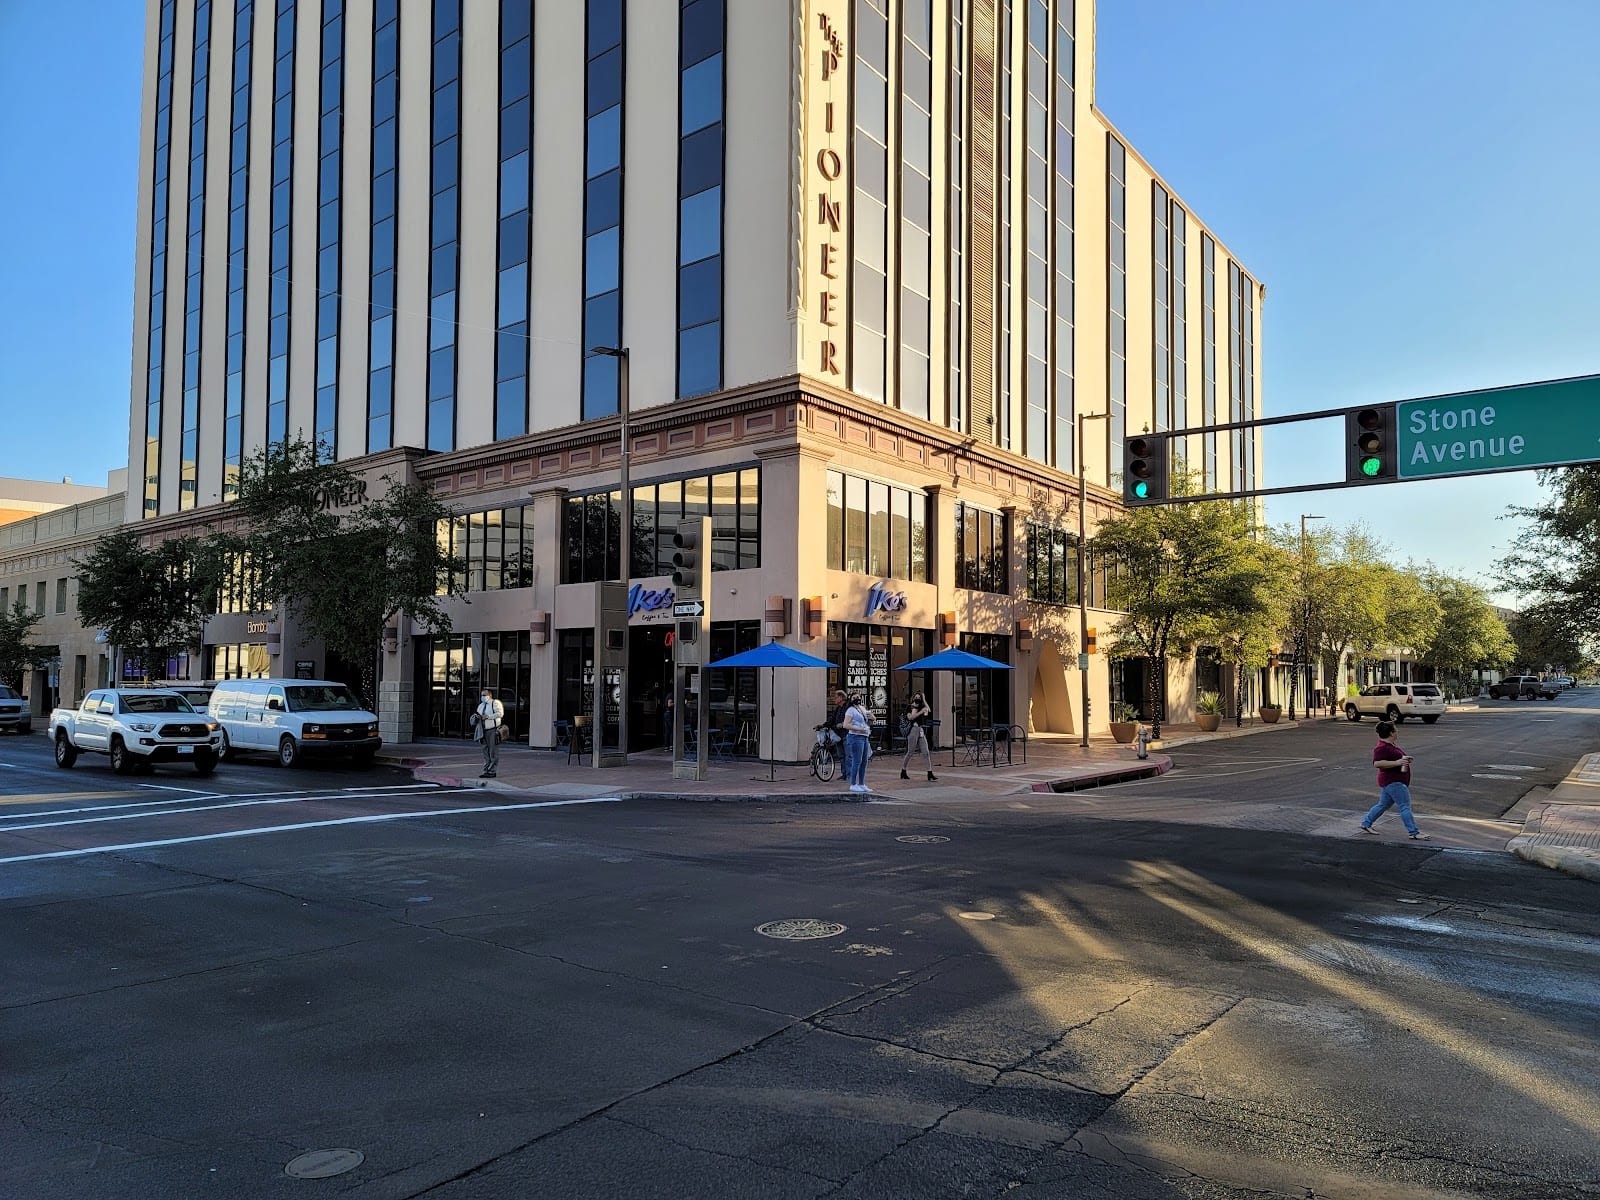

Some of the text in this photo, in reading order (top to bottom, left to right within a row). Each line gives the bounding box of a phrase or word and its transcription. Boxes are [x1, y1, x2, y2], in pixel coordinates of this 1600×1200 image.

[817, 50, 841, 375] PIONEER
[1410, 406, 1496, 434] Stone
[1410, 434, 1525, 465] Avenue
[314, 480, 369, 511] ONEER
[584, 675, 620, 684] LATE
[847, 676, 887, 687] LATTES
